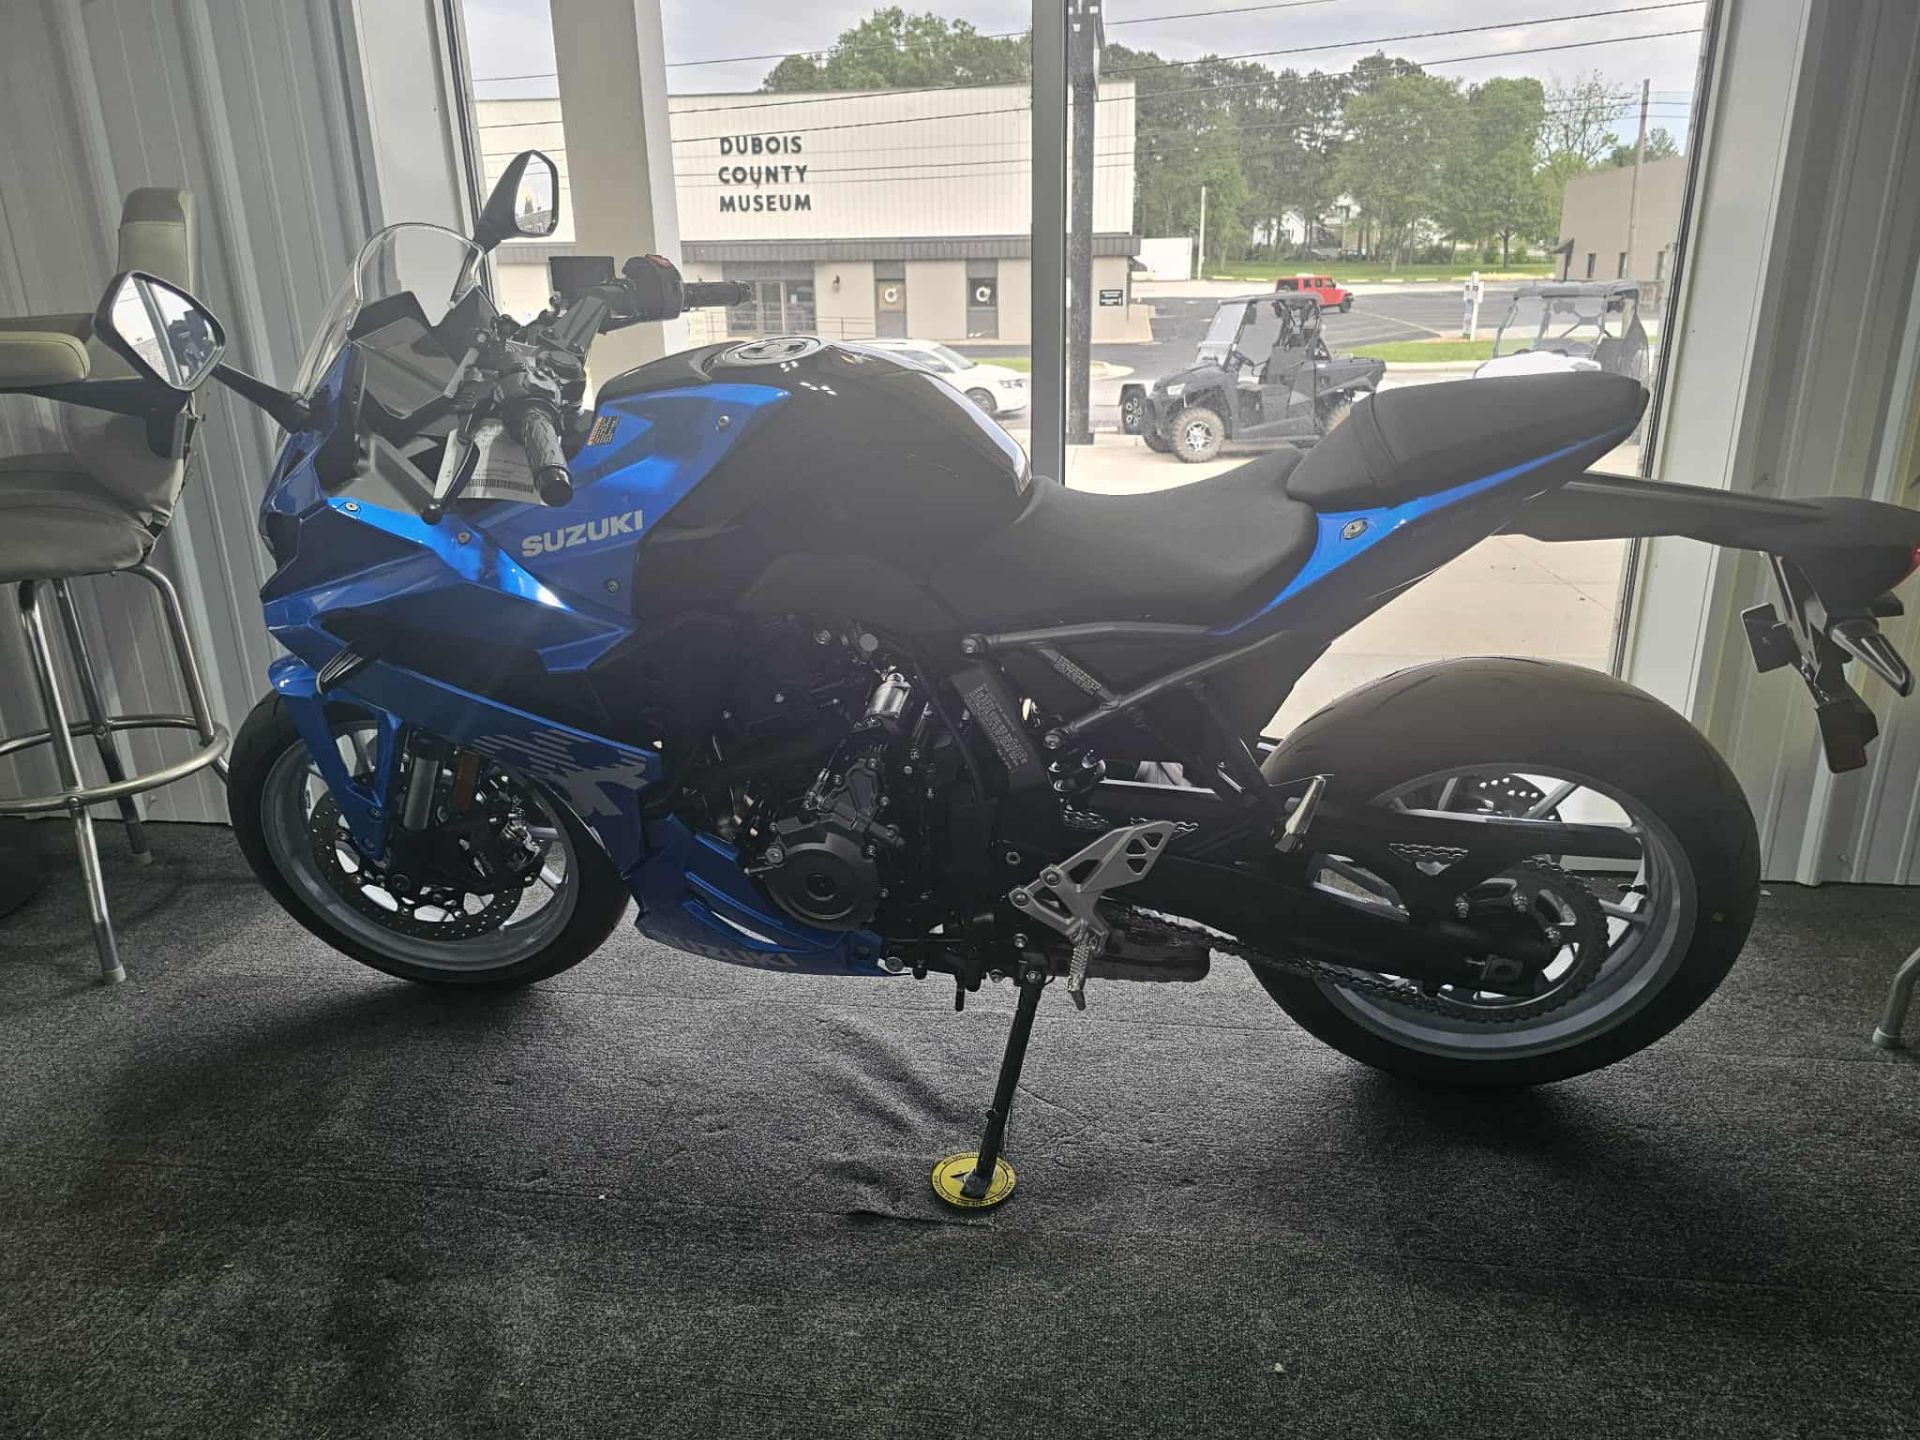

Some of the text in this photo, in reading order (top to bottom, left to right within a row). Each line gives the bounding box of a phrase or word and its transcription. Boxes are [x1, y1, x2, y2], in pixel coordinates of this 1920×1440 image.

[720, 136, 802, 155] DUBOIS
[718, 165, 807, 184] COUNTY
[719, 194, 812, 212] MUSEUM
[521, 510, 644, 558] SUZUKI
